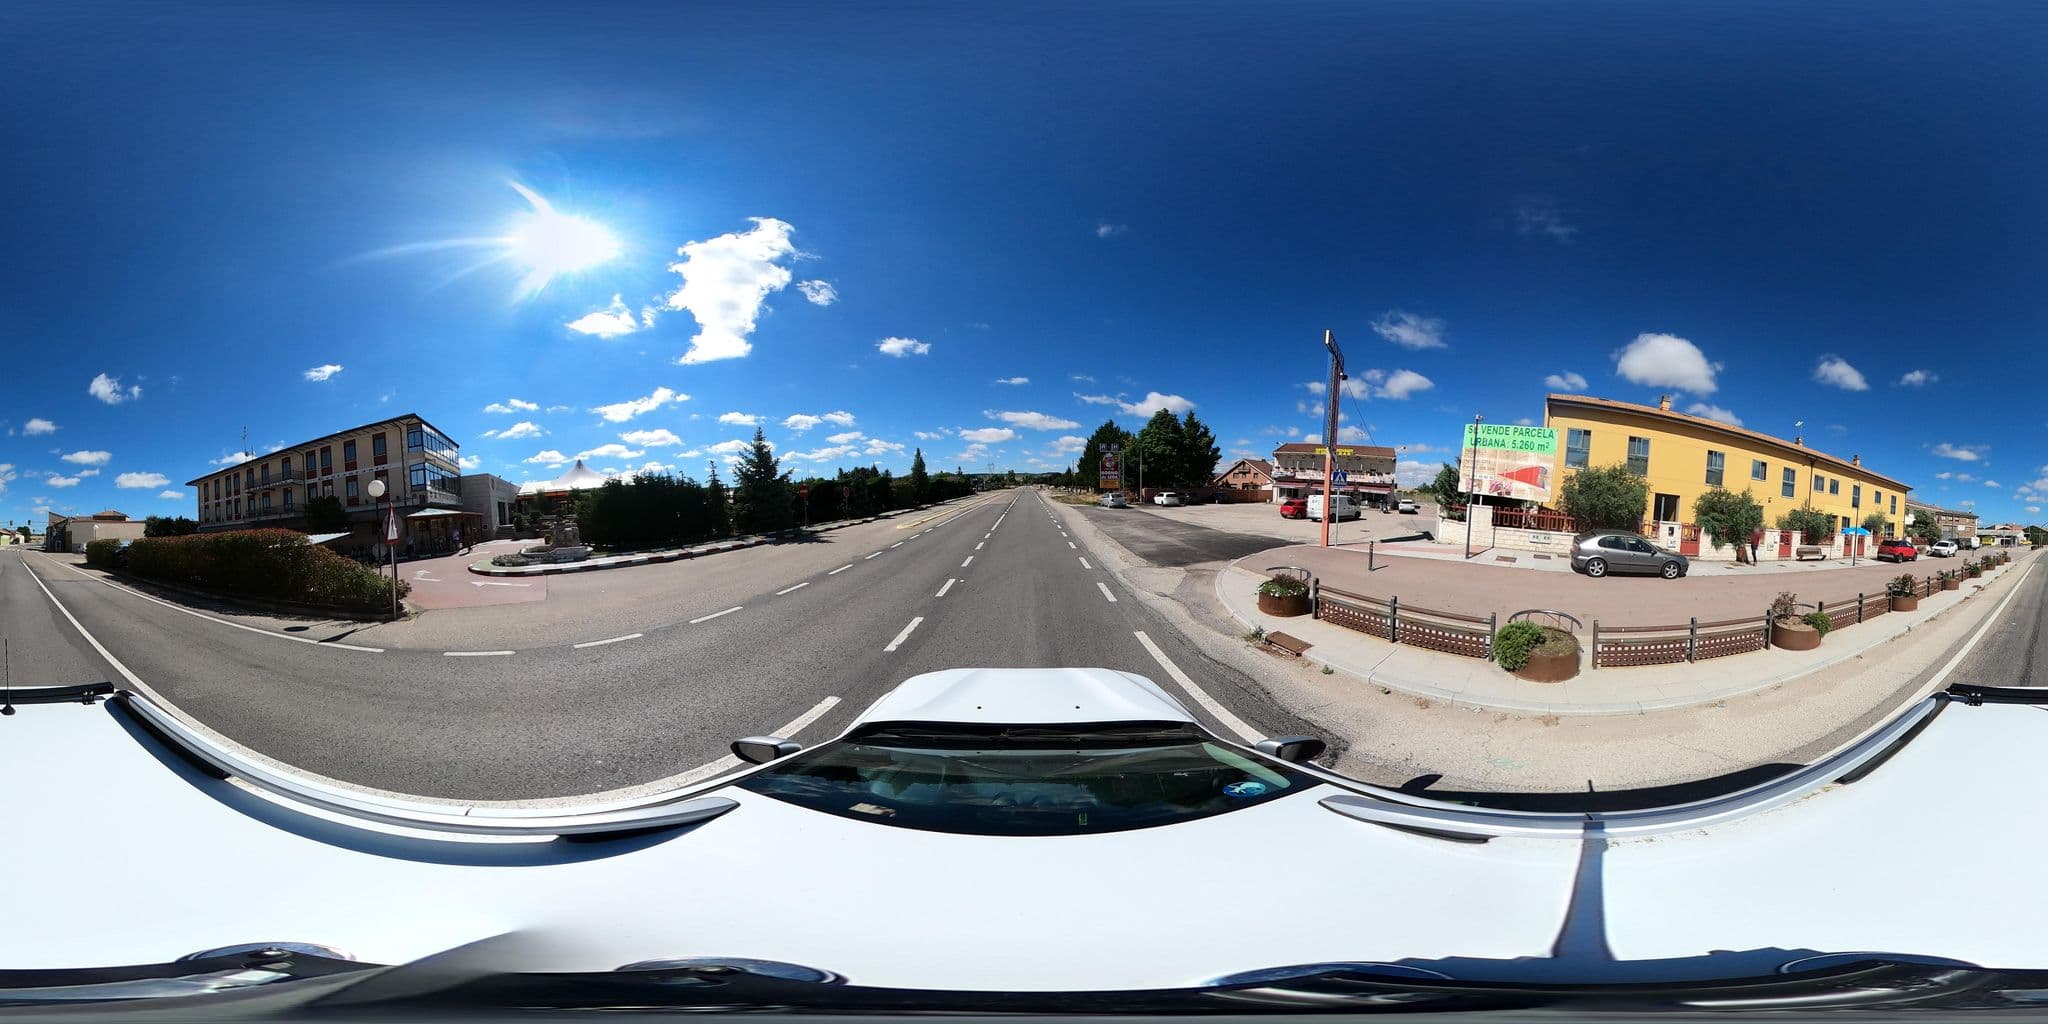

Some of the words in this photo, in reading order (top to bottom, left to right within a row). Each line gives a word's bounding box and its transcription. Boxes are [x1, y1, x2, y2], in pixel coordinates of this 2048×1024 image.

[1481, 425, 1511, 436] VENDE
[1513, 427, 1554, 439] PARCELA
[1511, 439, 1535, 450] 5.260
